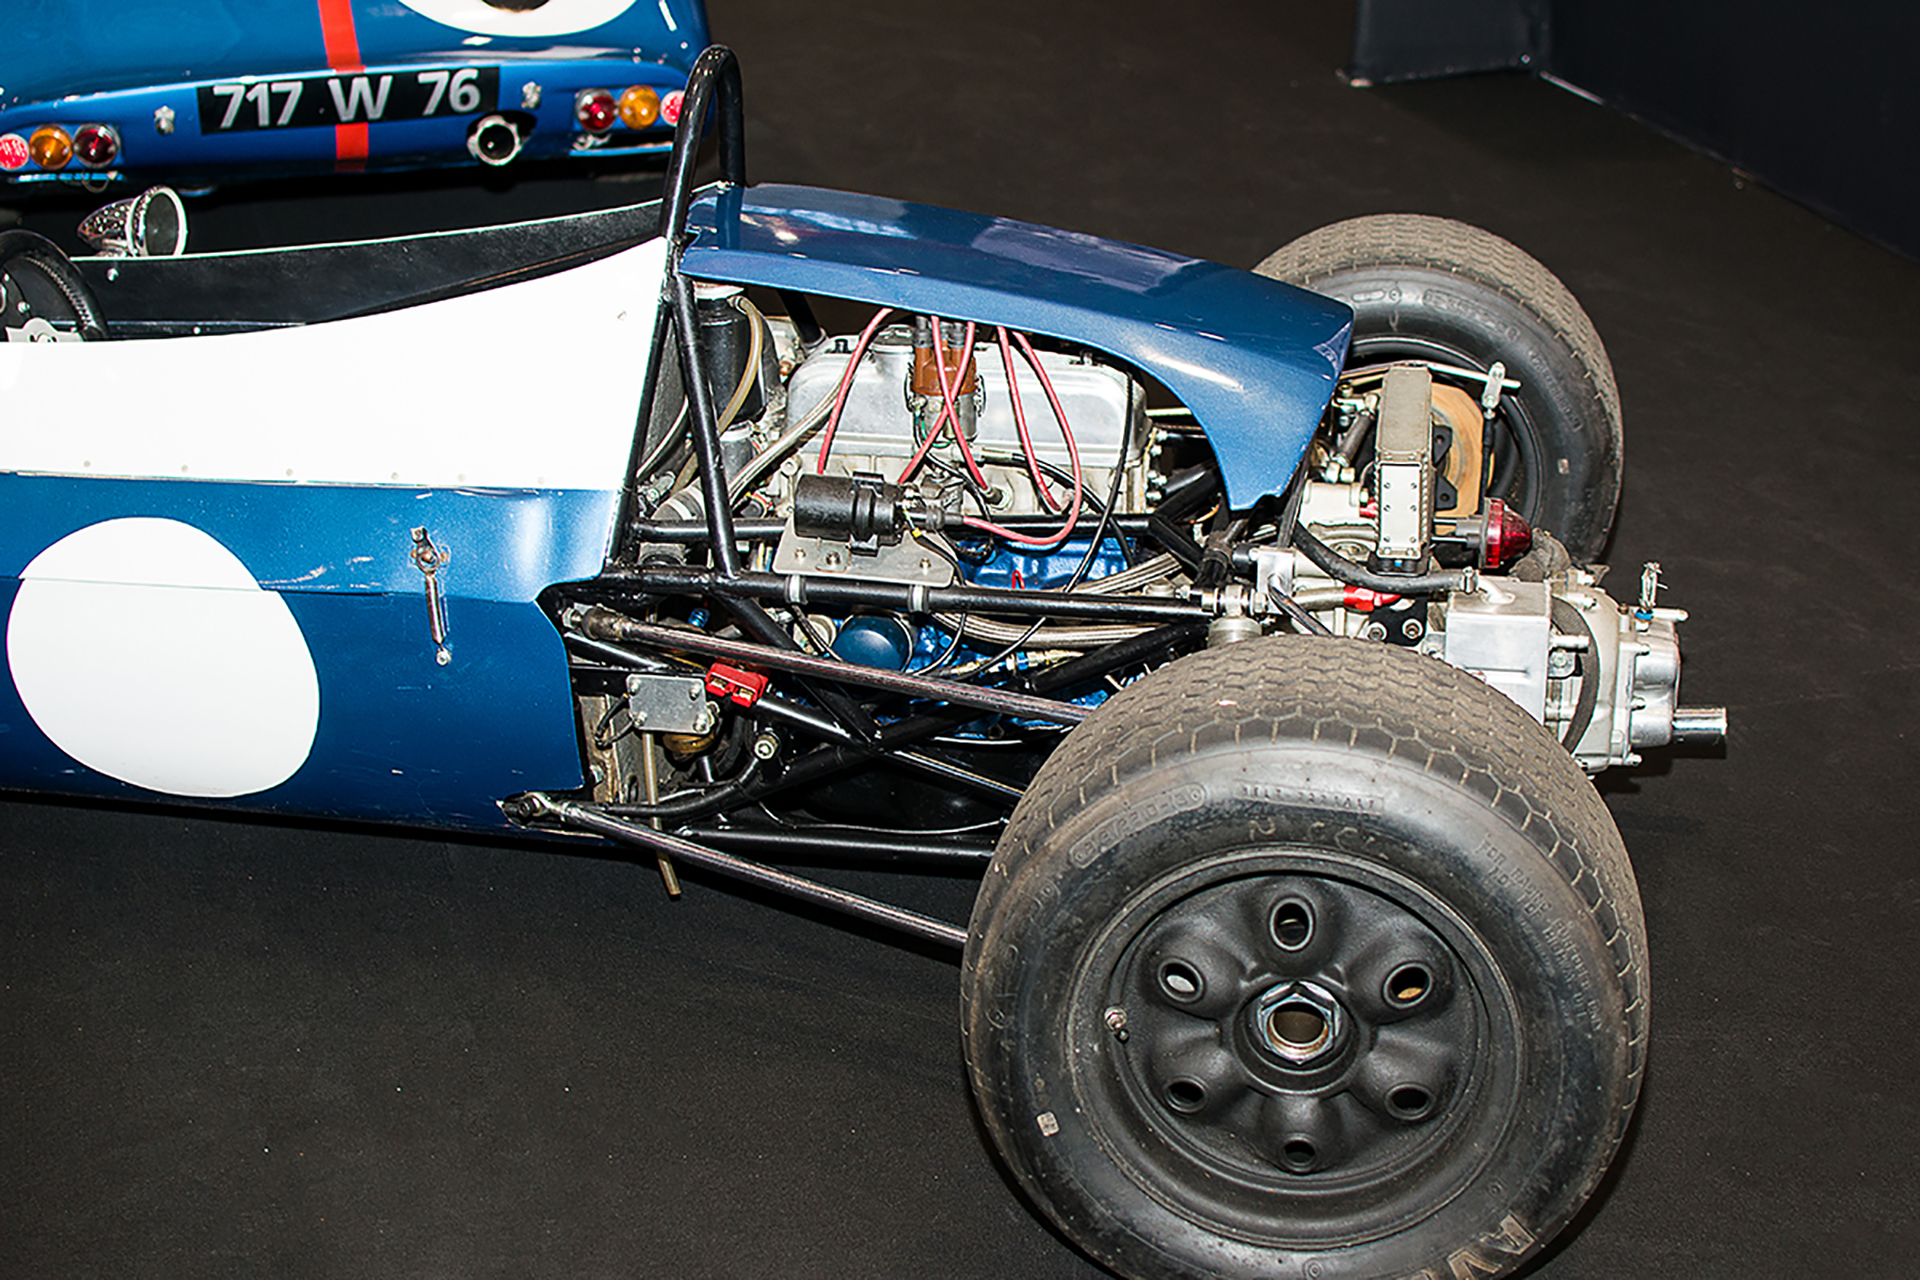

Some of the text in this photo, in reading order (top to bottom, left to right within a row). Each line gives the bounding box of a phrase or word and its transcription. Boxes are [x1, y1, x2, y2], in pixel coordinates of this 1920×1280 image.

[212, 68, 481, 129] 717 W 76
